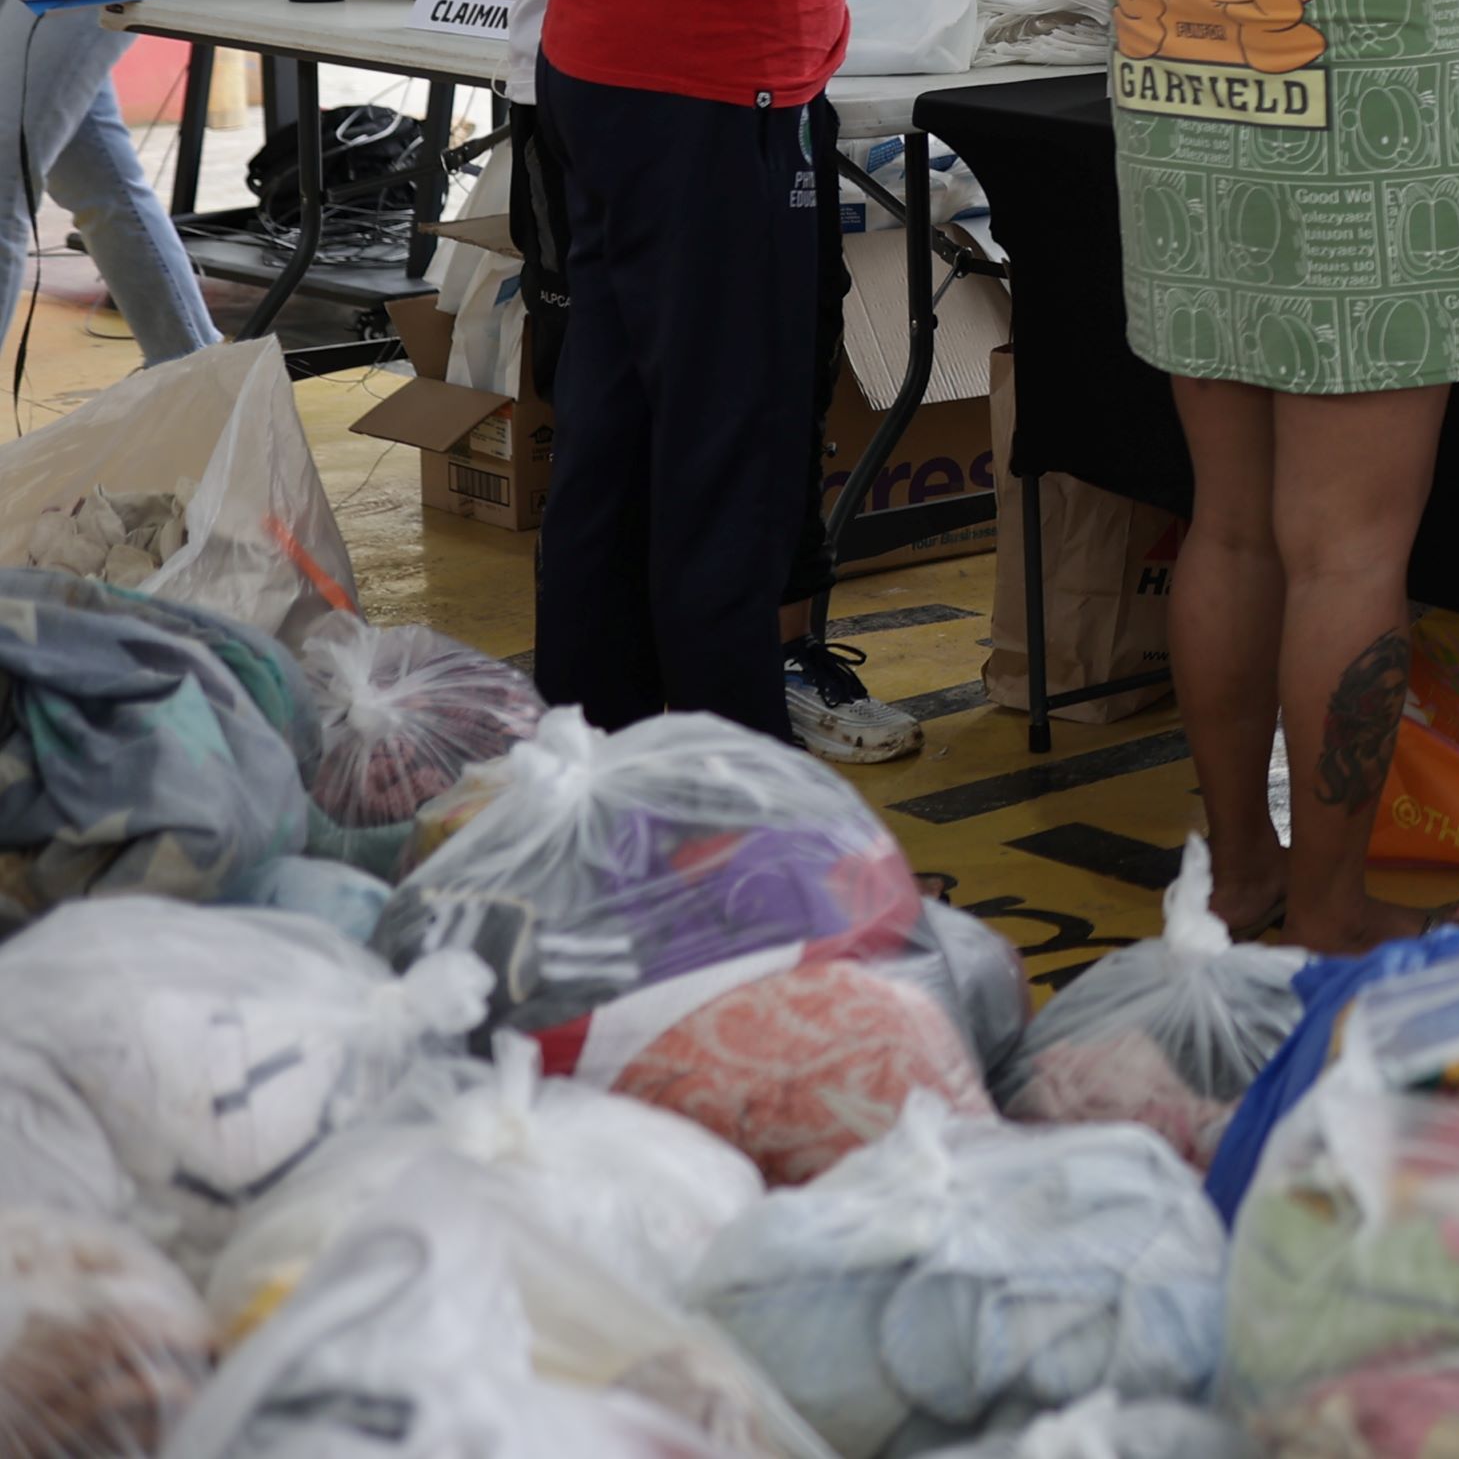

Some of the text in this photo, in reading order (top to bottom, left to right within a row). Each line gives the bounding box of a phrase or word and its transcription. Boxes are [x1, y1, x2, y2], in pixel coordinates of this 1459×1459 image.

[430, 0, 510, 30] CLAIMIN
[1119, 61, 1310, 116] GARFIELD
[1295, 188, 1340, 204] Good
